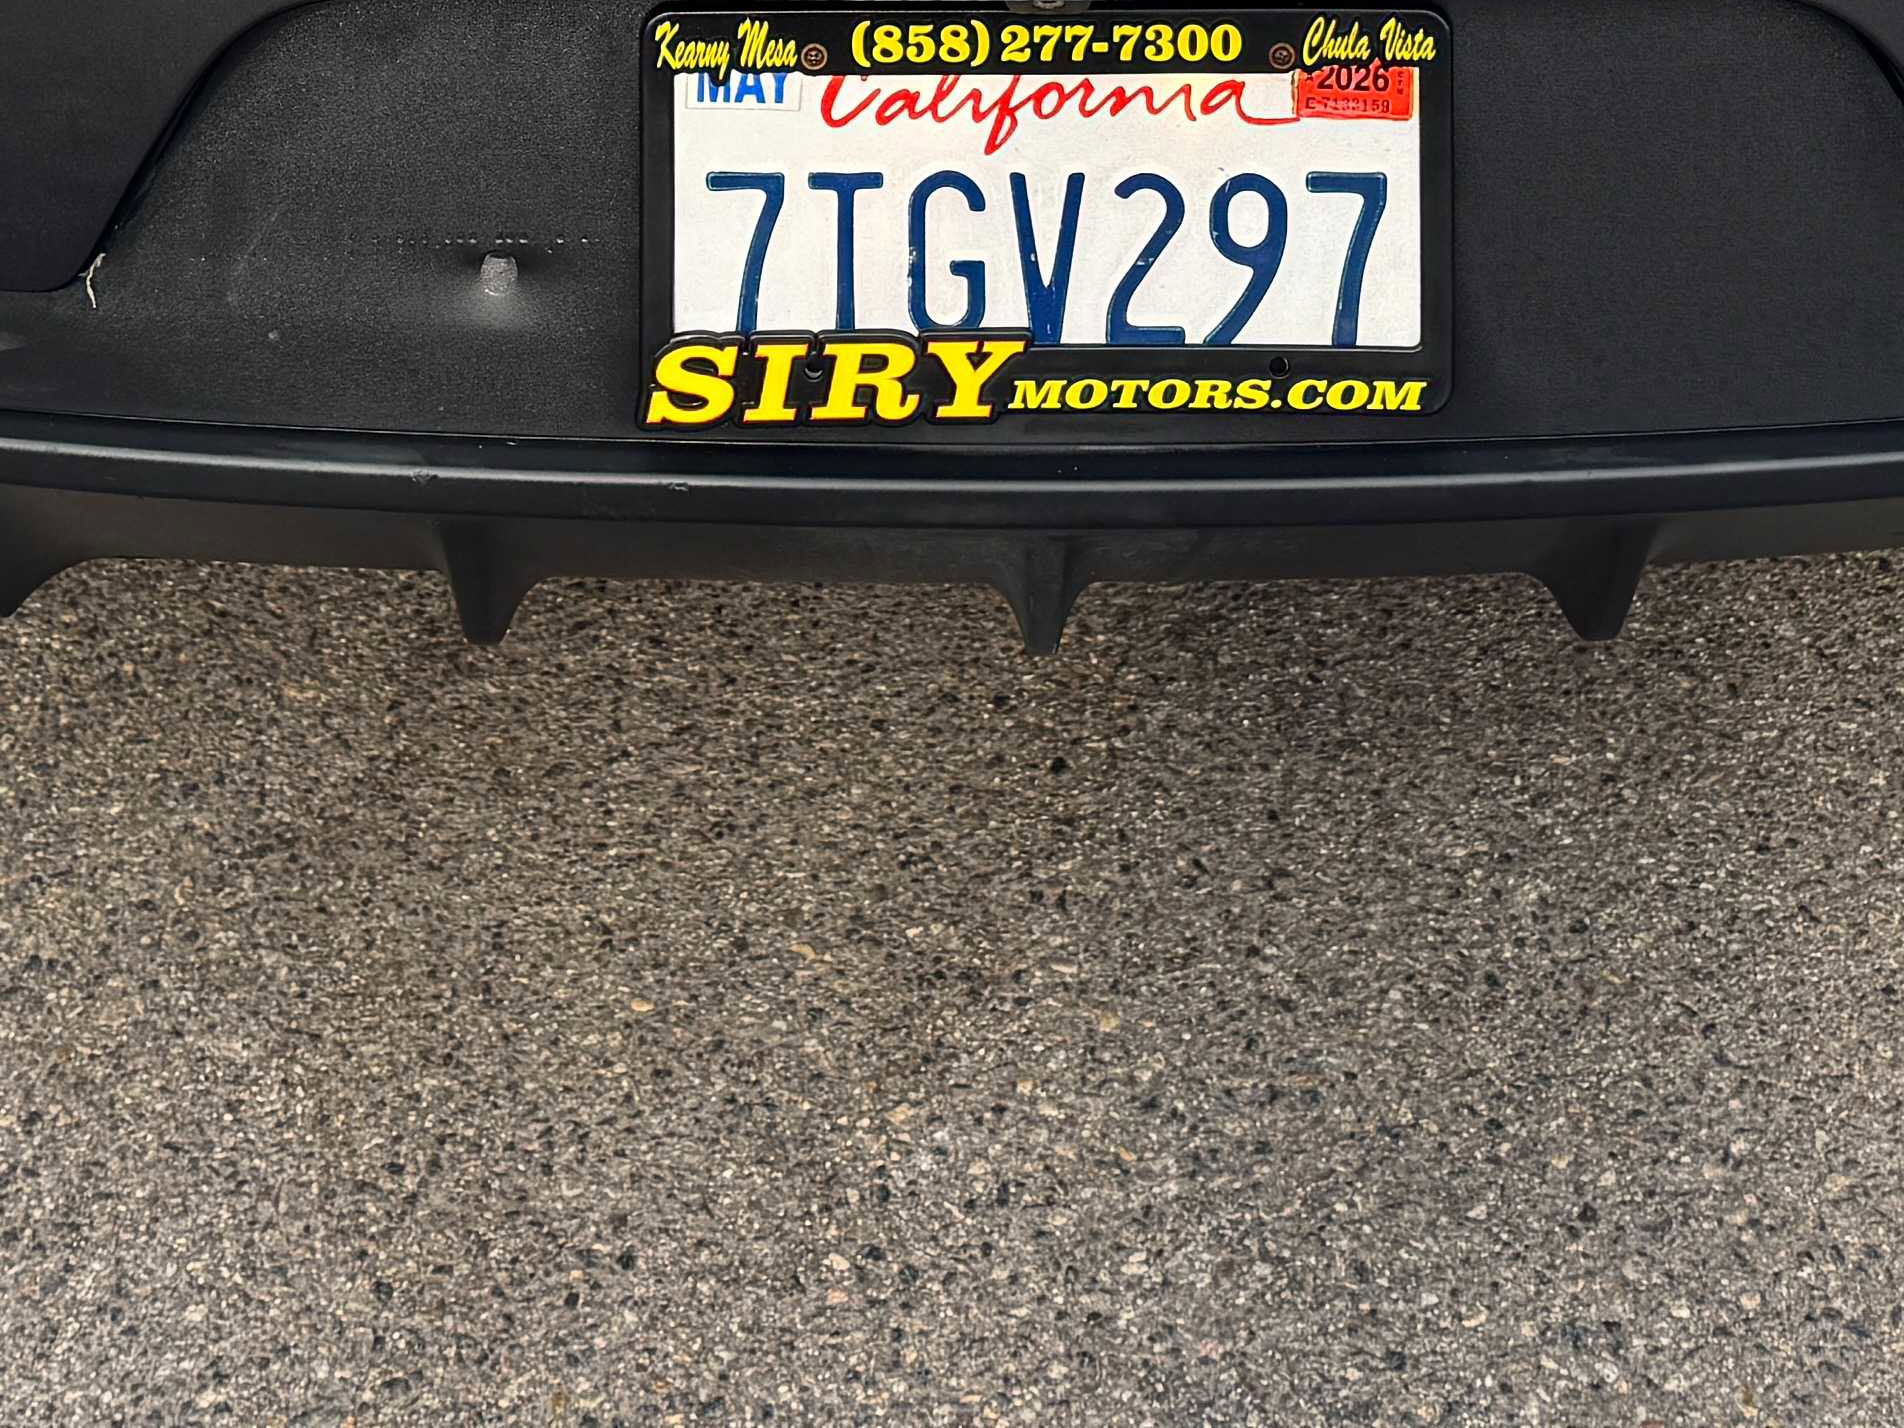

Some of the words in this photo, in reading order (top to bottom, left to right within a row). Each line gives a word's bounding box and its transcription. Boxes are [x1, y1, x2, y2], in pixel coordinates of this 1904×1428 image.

[654, 19, 730, 81] Kearny
[737, 16, 799, 69] Mesa
[851, 19, 990, 68] (858)
[1000, 22, 1243, 64] 277-7300
[1302, 16, 1372, 66] Chula
[1379, 19, 1438, 62] Vista
[696, 71, 789, 104] MAY
[1316, 65, 1390, 92] 2026
[820, 74, 1300, 156] California
[705, 168, 1391, 346] 7TGV297
[645, 338, 1028, 425] SIRY
[1007, 377, 1426, 414] MOTORS.COM
